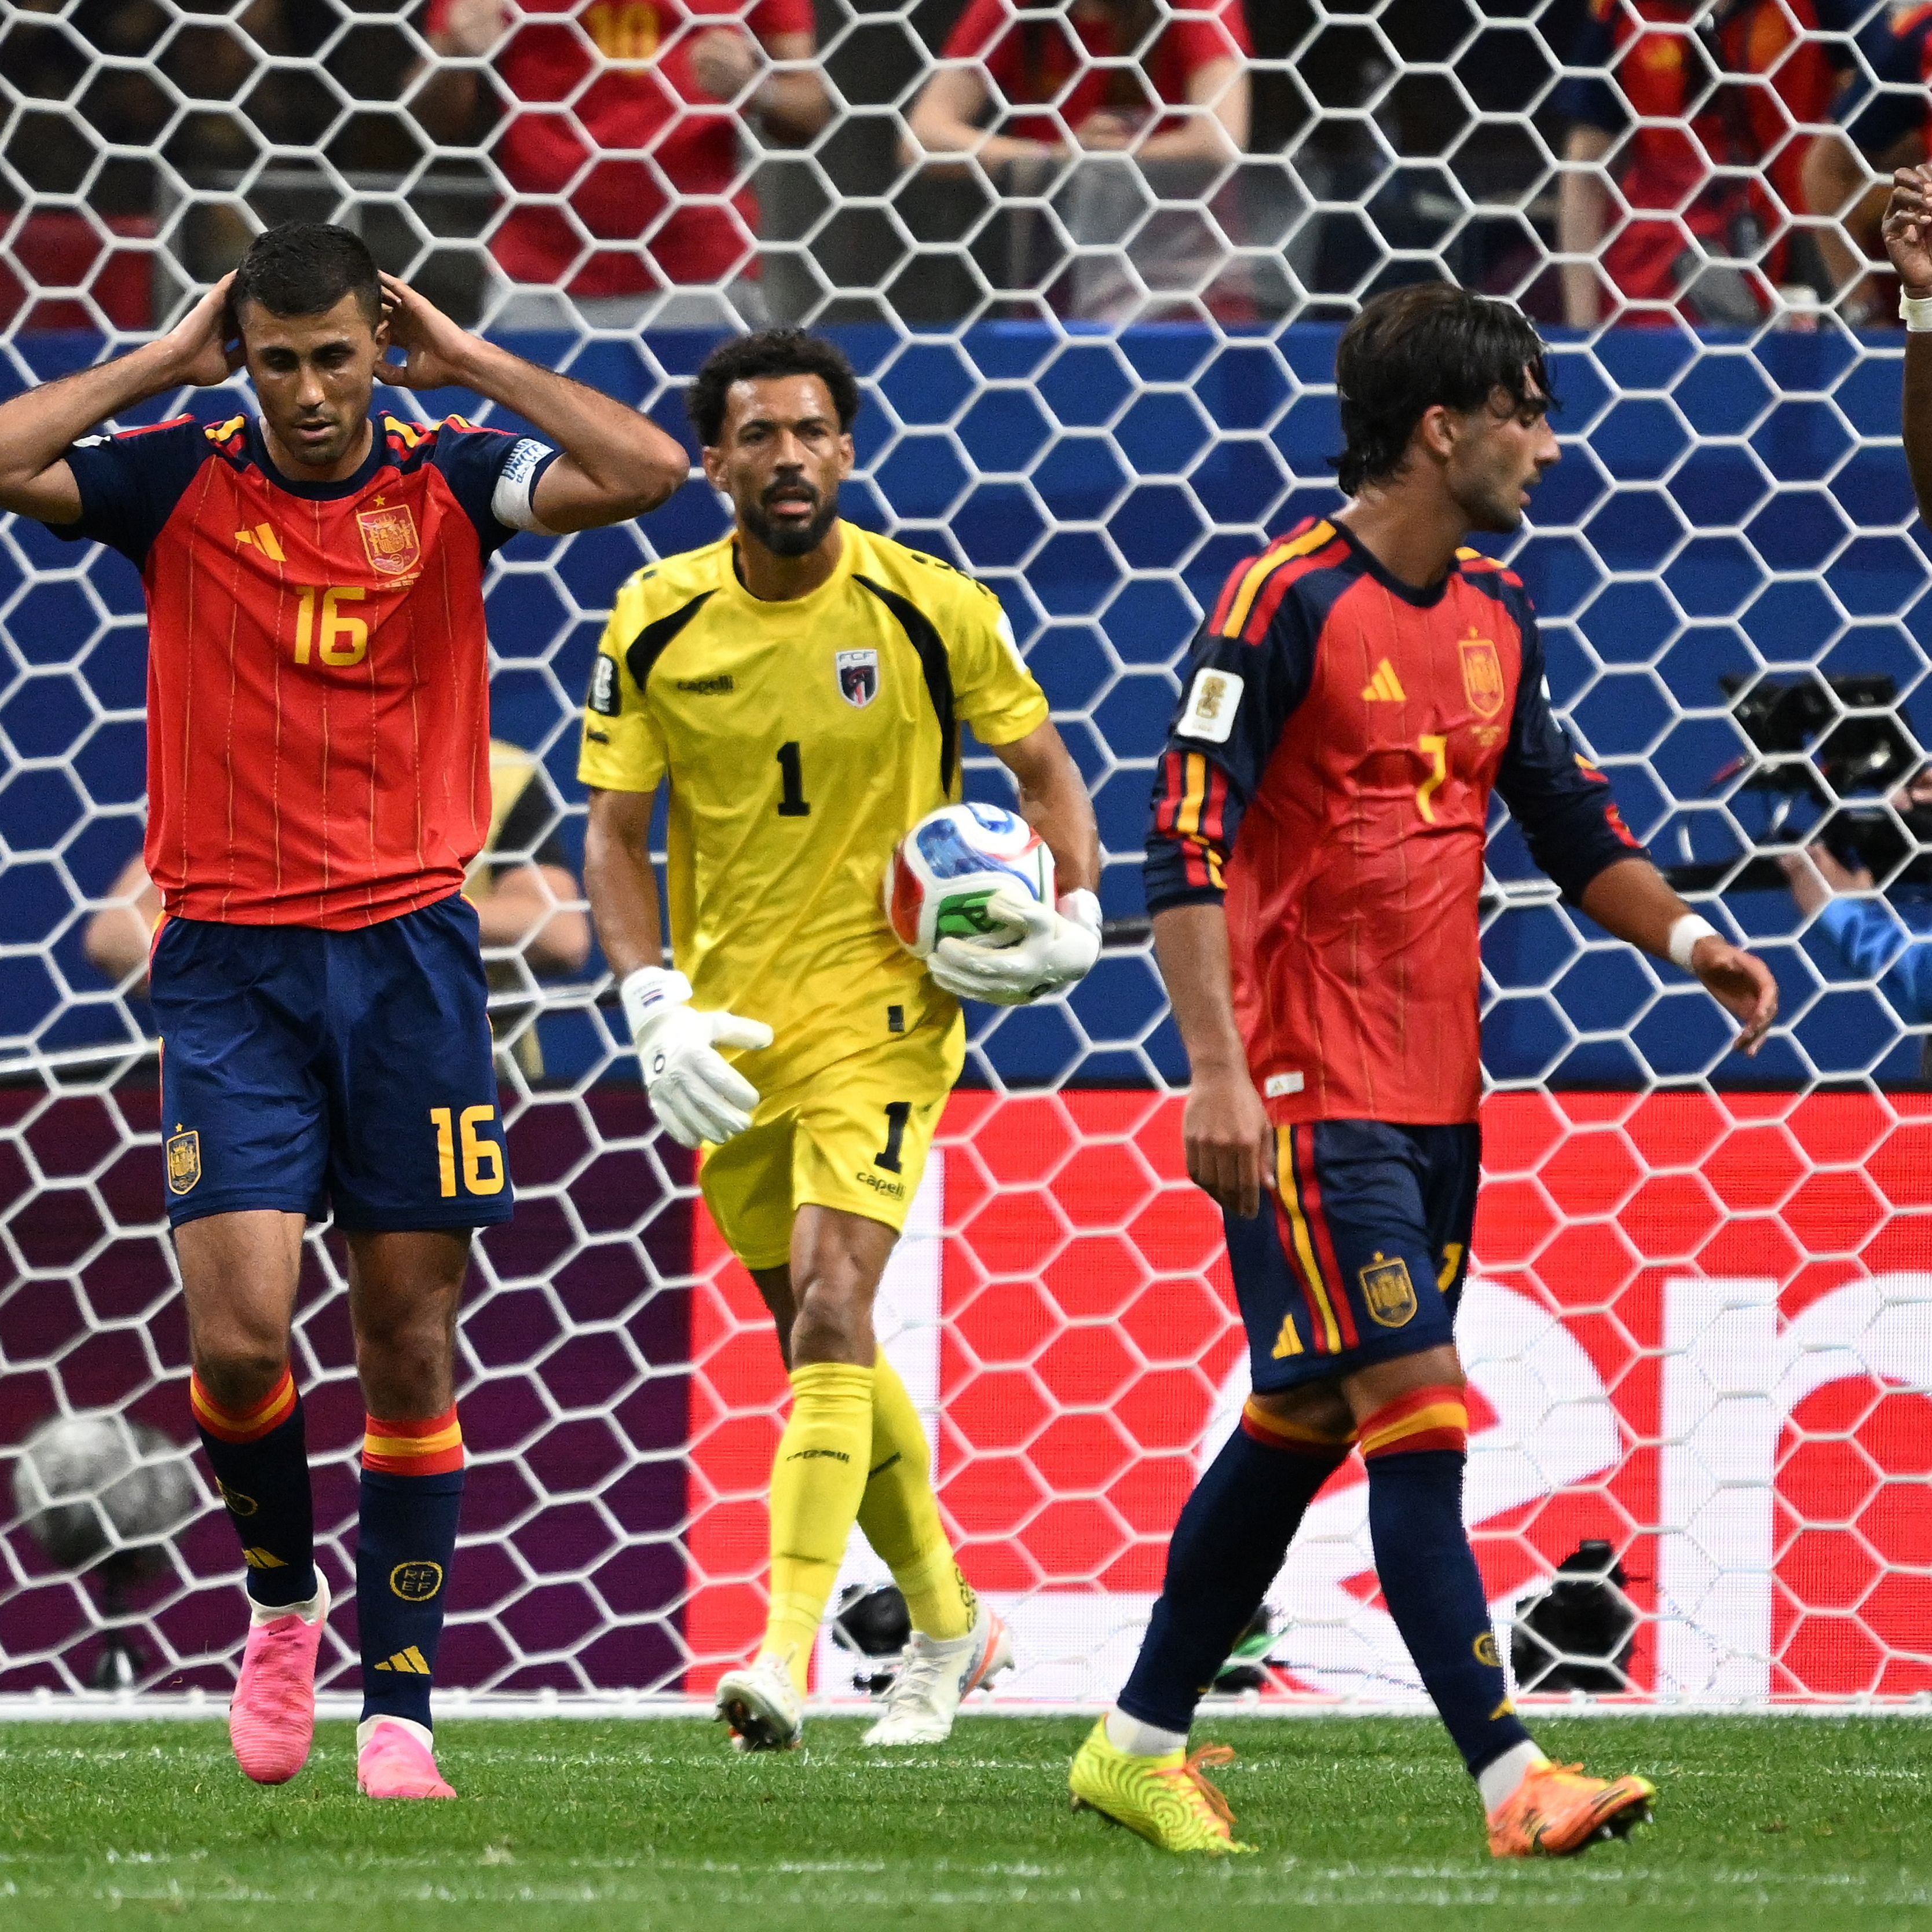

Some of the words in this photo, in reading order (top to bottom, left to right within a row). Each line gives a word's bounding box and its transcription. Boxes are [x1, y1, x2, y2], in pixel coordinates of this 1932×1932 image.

[294, 586, 368, 665] 16
[777, 741, 810, 815] 1
[1416, 734, 1447, 825] 7
[430, 1105, 504, 1197] 16
[874, 1101, 912, 1173] 1
[402, 1580, 431, 1592] EF
[404, 1569, 433, 1580] RF
